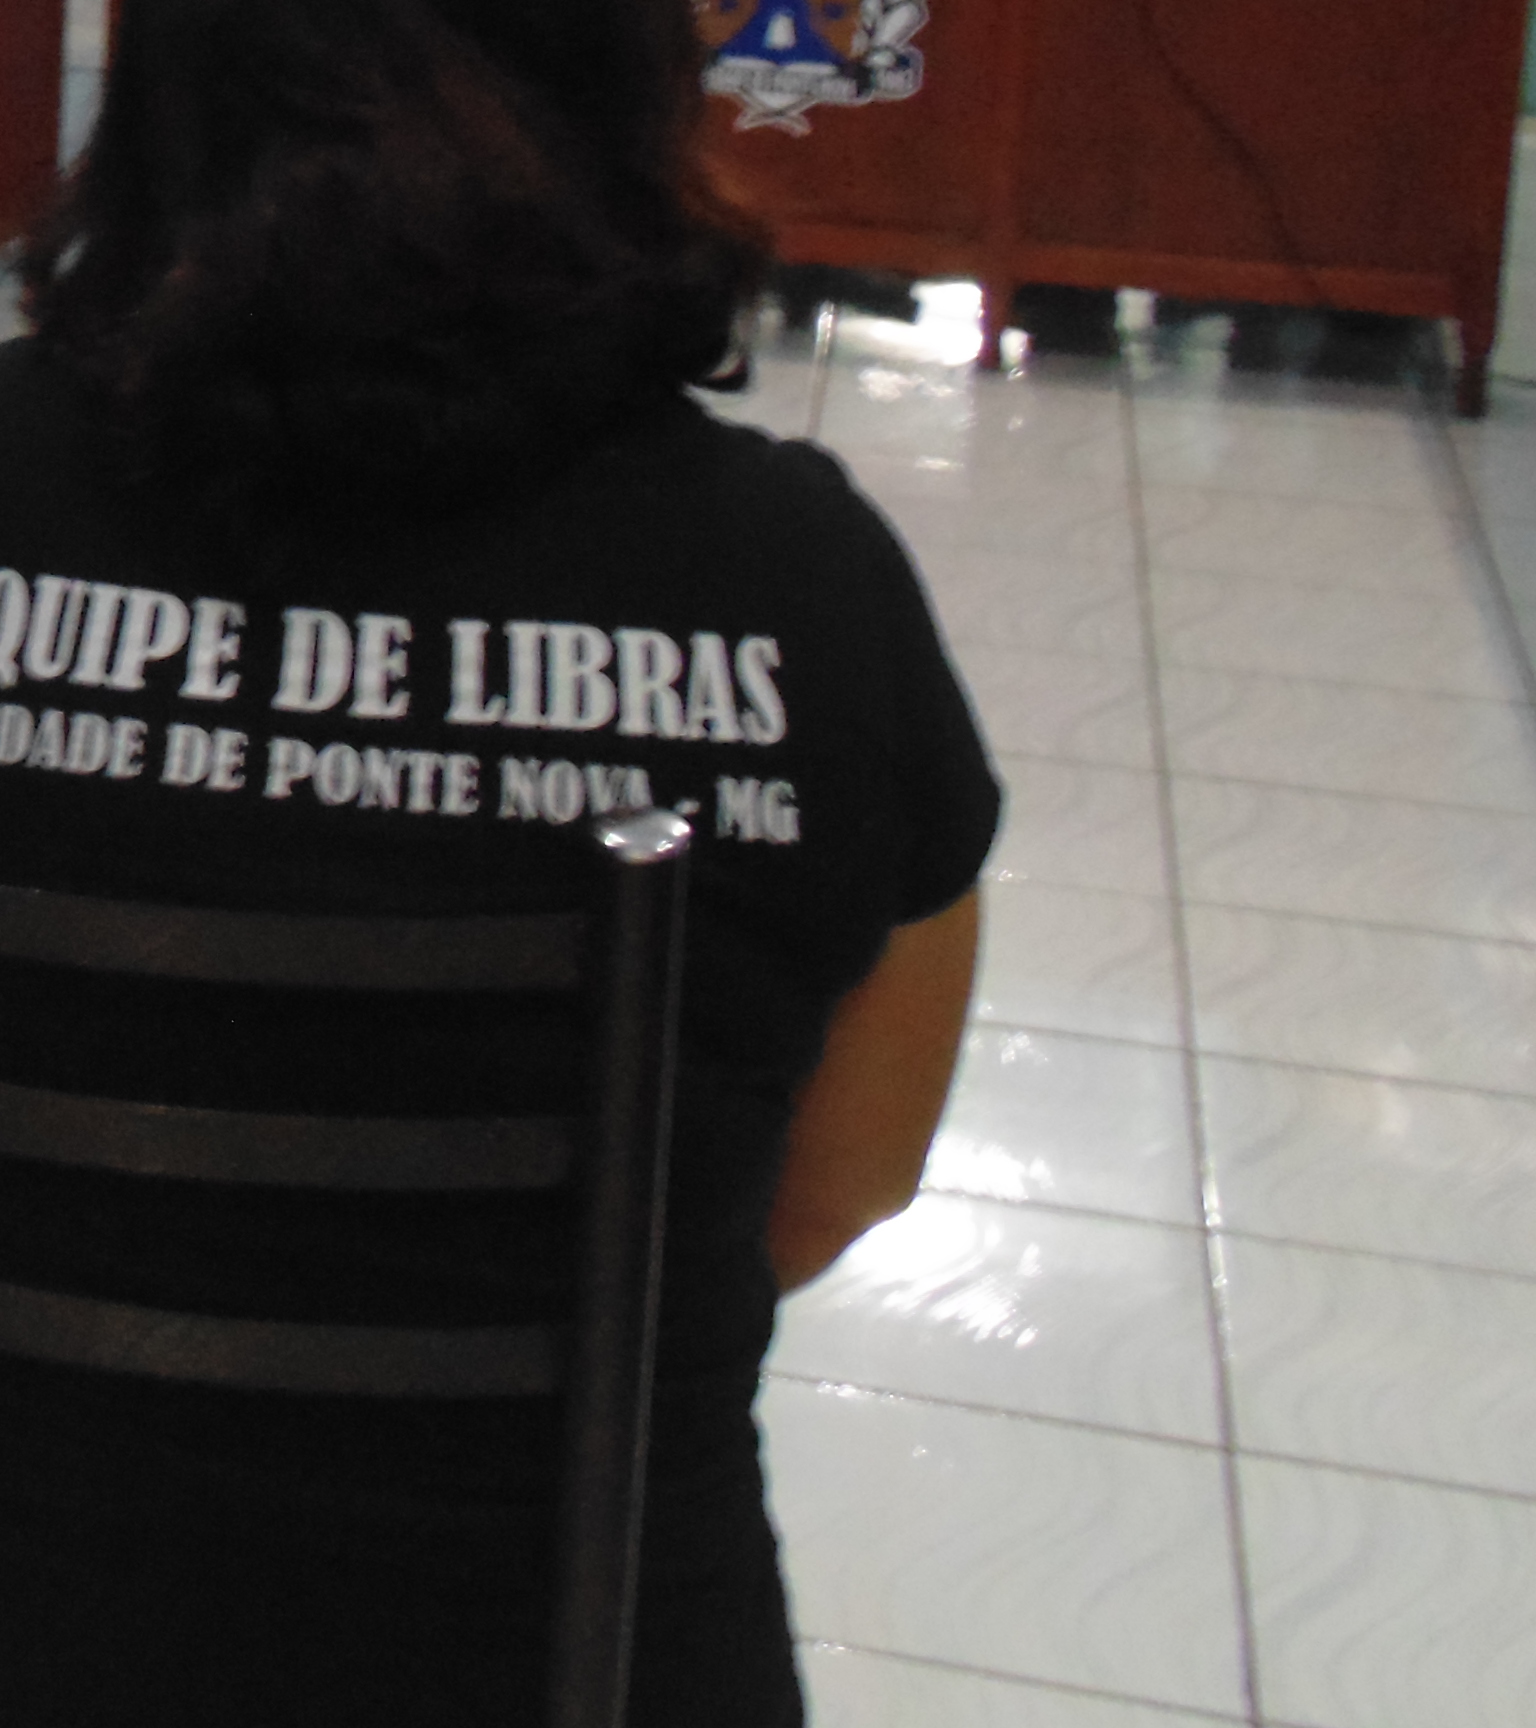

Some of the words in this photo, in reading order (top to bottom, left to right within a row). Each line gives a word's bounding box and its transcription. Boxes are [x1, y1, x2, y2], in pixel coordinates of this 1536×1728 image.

[270, 607, 413, 720] DE
[445, 618, 787, 746] LIBRAS
[161, 722, 250, 792] DE
[263, 736, 481, 816] PONTE
[716, 776, 800, 844] MG
